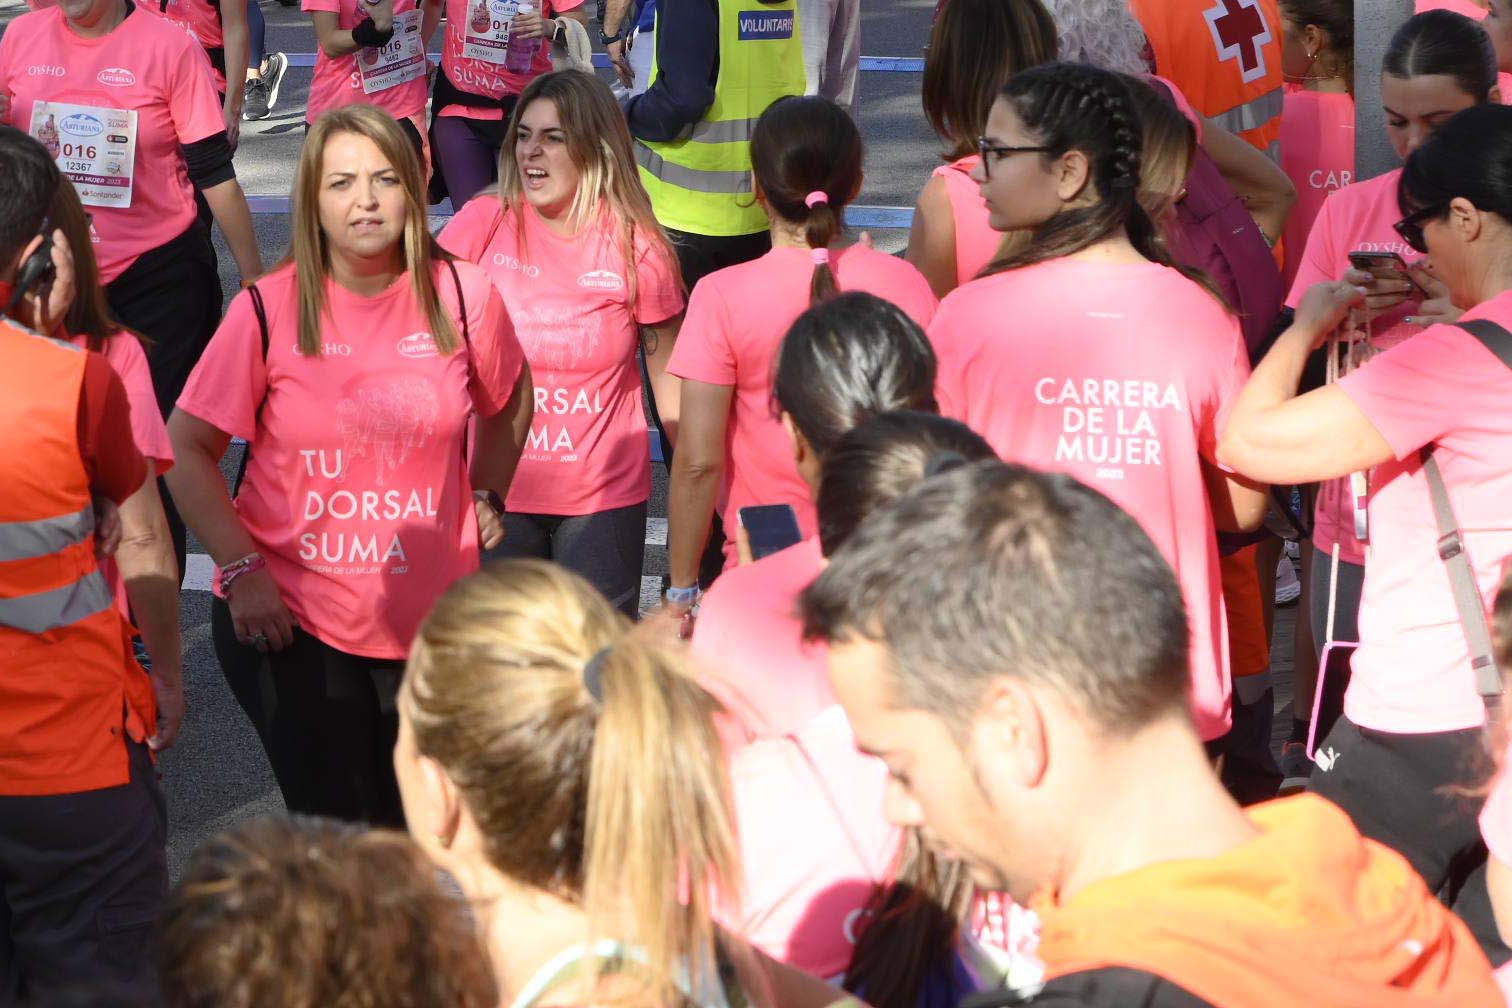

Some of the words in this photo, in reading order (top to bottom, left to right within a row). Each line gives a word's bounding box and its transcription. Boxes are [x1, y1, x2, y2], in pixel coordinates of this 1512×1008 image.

[492, 20, 509, 30] 01
[740, 18, 793, 32] VOLUNTARIS
[380, 41, 401, 56] 016
[454, 67, 506, 90] SUMA
[63, 121, 99, 132] ASTURIANA
[63, 144, 96, 158] 016
[65, 161, 92, 171] 12367
[90, 190, 124, 199] Santander
[1034, 377, 1182, 411] CARRERA
[1063, 407, 1104, 434] DE
[1116, 408, 1156, 436] LA
[1055, 435, 1161, 465] MUJER
[299, 448, 342, 479] TU
[303, 487, 437, 521] DORSAL
[298, 533, 407, 563] SUMA
